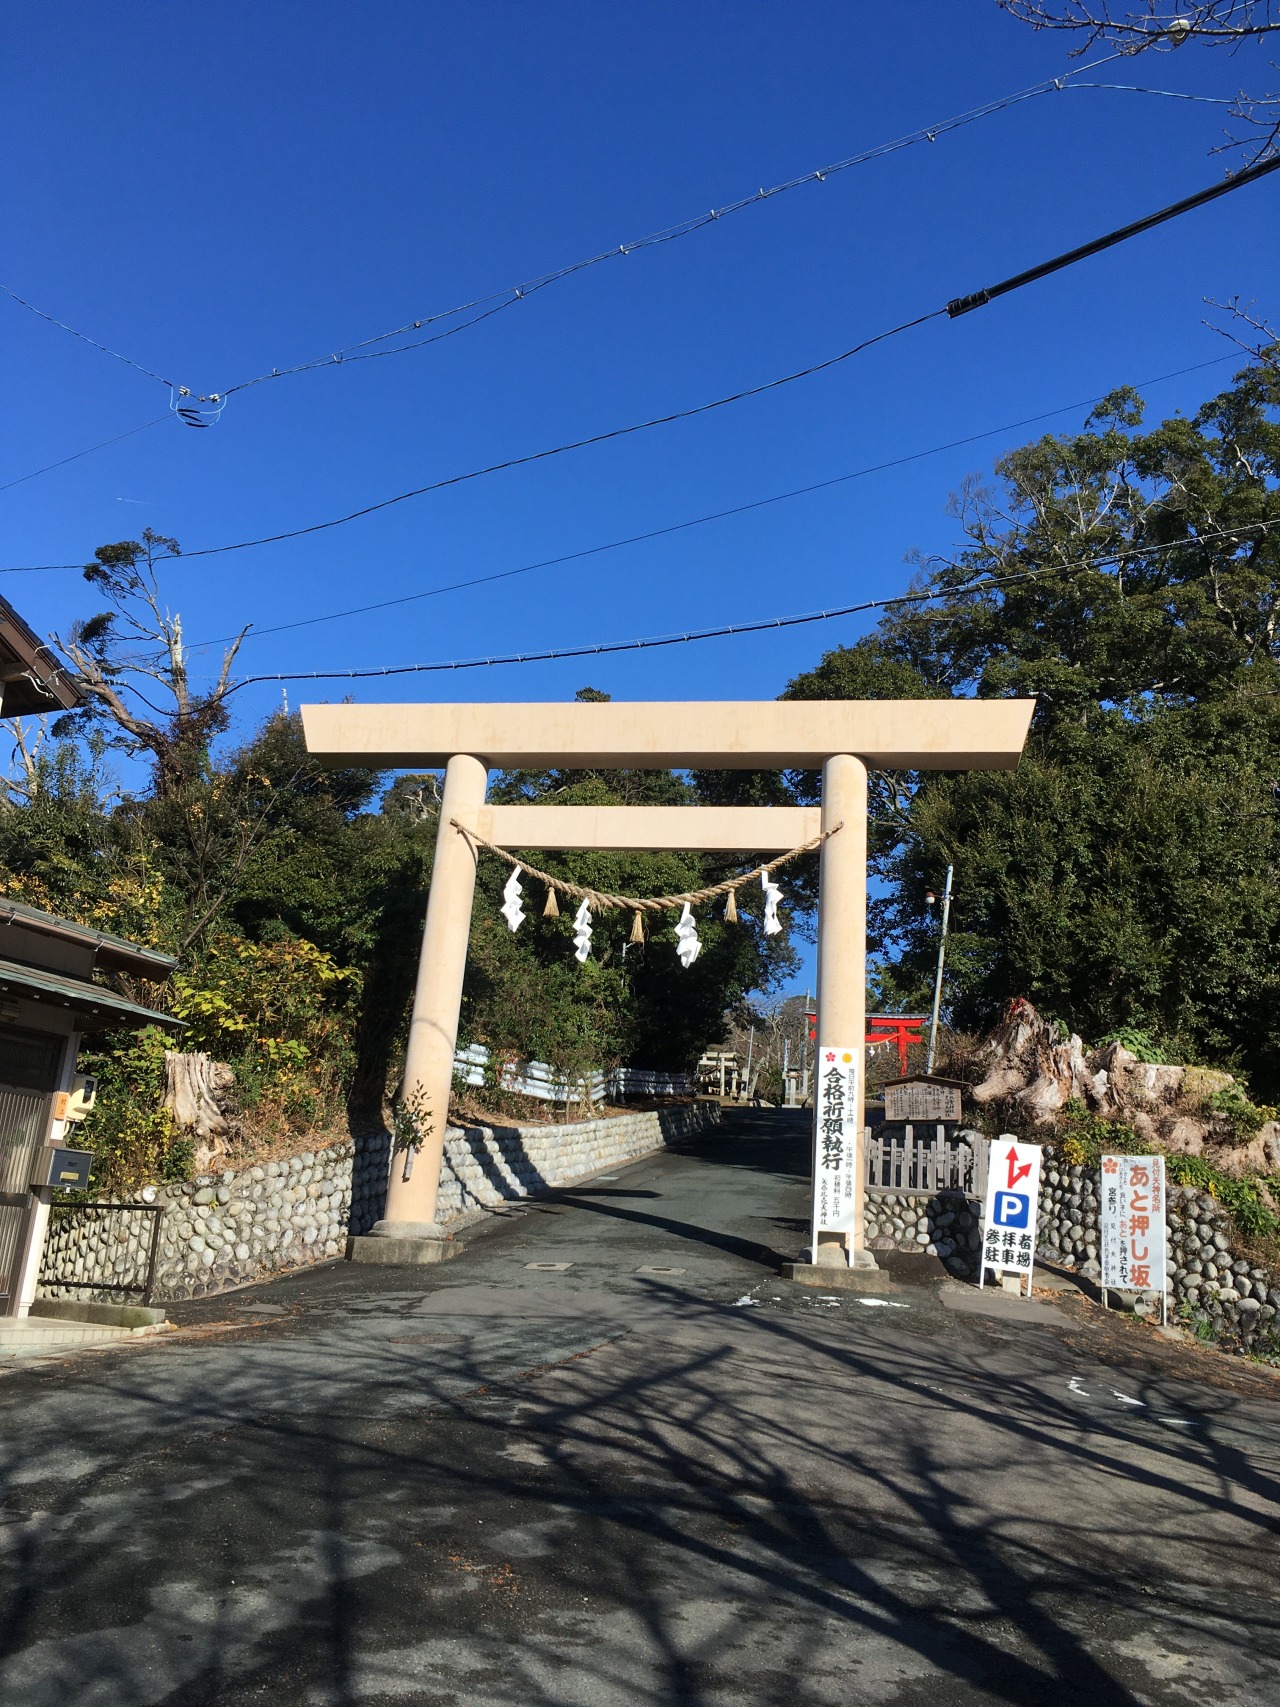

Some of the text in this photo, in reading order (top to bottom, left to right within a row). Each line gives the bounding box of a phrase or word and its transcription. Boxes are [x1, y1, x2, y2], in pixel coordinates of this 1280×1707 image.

[820, 1066, 847, 1171] 合格祈願執行
[1151, 1158, 1162, 1214] 見付天神名所
[1000, 1195, 1023, 1223] P
[1129, 1164, 1152, 1288] あと押し坂
[984, 1246, 1032, 1268] 駐車場
[985, 1228, 1033, 1250] 参拝者
